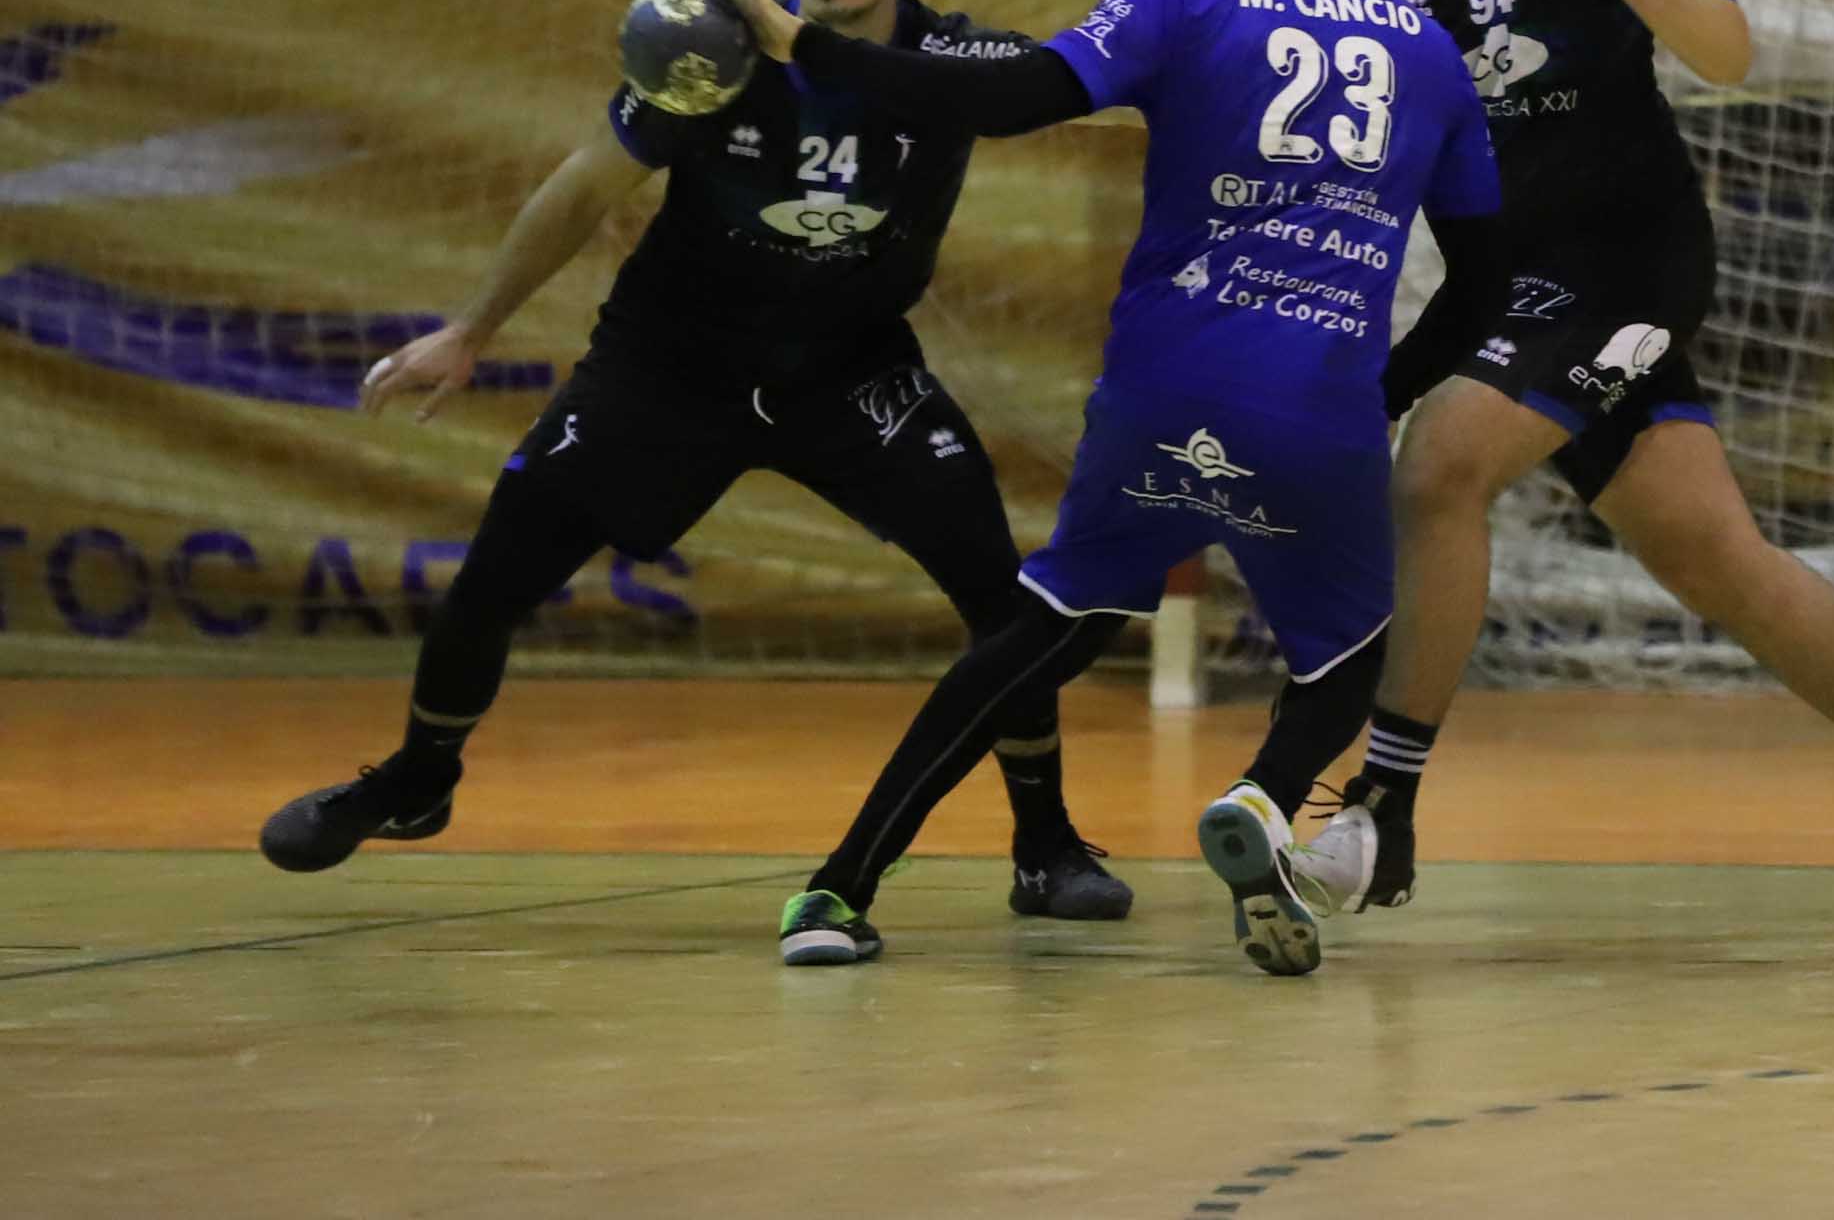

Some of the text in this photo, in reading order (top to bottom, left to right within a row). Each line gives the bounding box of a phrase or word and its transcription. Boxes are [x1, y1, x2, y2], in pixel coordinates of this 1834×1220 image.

[1258, 27, 1397, 172] 23
[1539, 88, 1578, 114] XXI
[796, 134, 860, 185] 24
[1211, 173, 1304, 208] RIAL
[796, 210, 857, 236] CG
[1312, 194, 1400, 229] FINANCIERA
[1319, 229, 1389, 270] Auto
[1217, 280, 1369, 338] Los Corzos
[1144, 471, 1267, 522] ESNA
